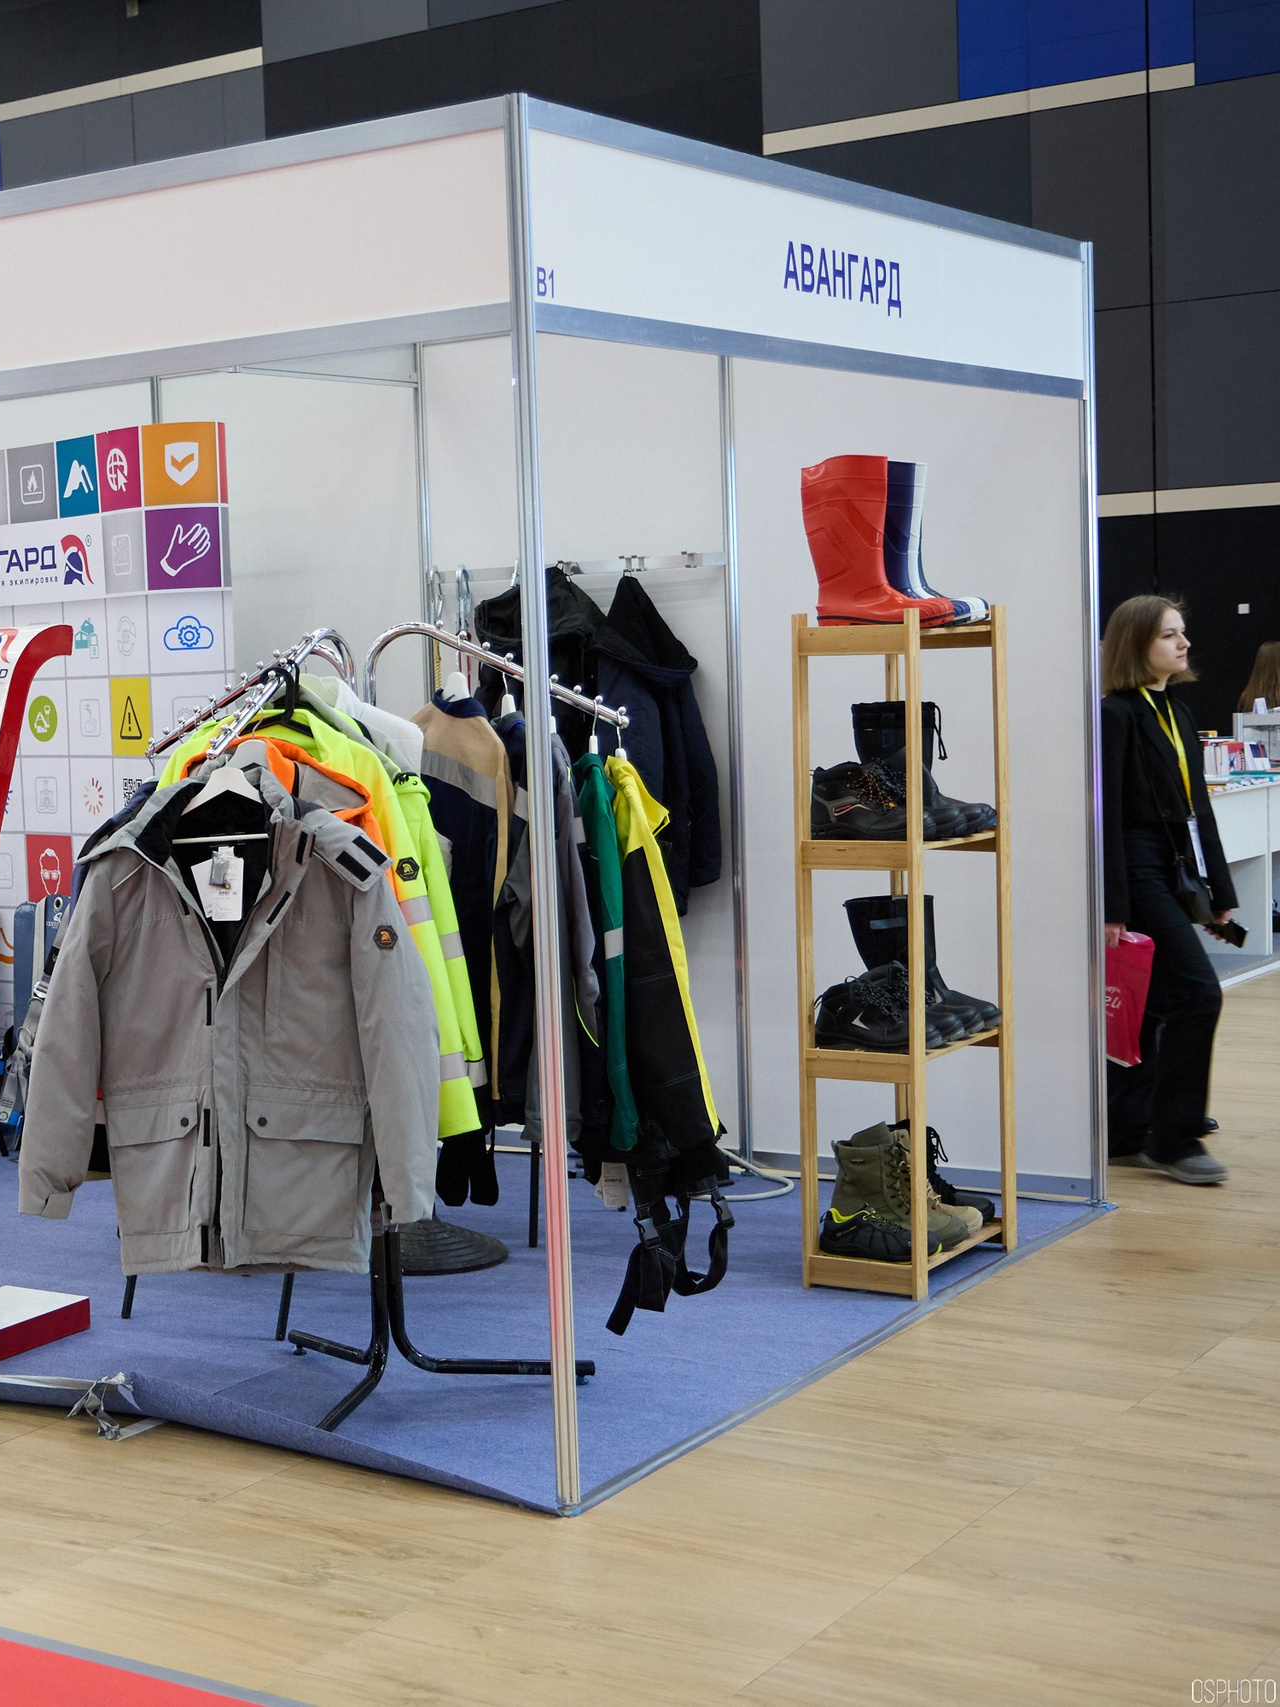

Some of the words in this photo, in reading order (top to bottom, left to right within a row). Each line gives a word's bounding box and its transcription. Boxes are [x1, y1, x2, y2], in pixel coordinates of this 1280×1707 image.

[537, 266, 555, 299] B1
[784, 240, 901, 318] АВАНГАРД
[9, 575, 58, 588] экипировка
